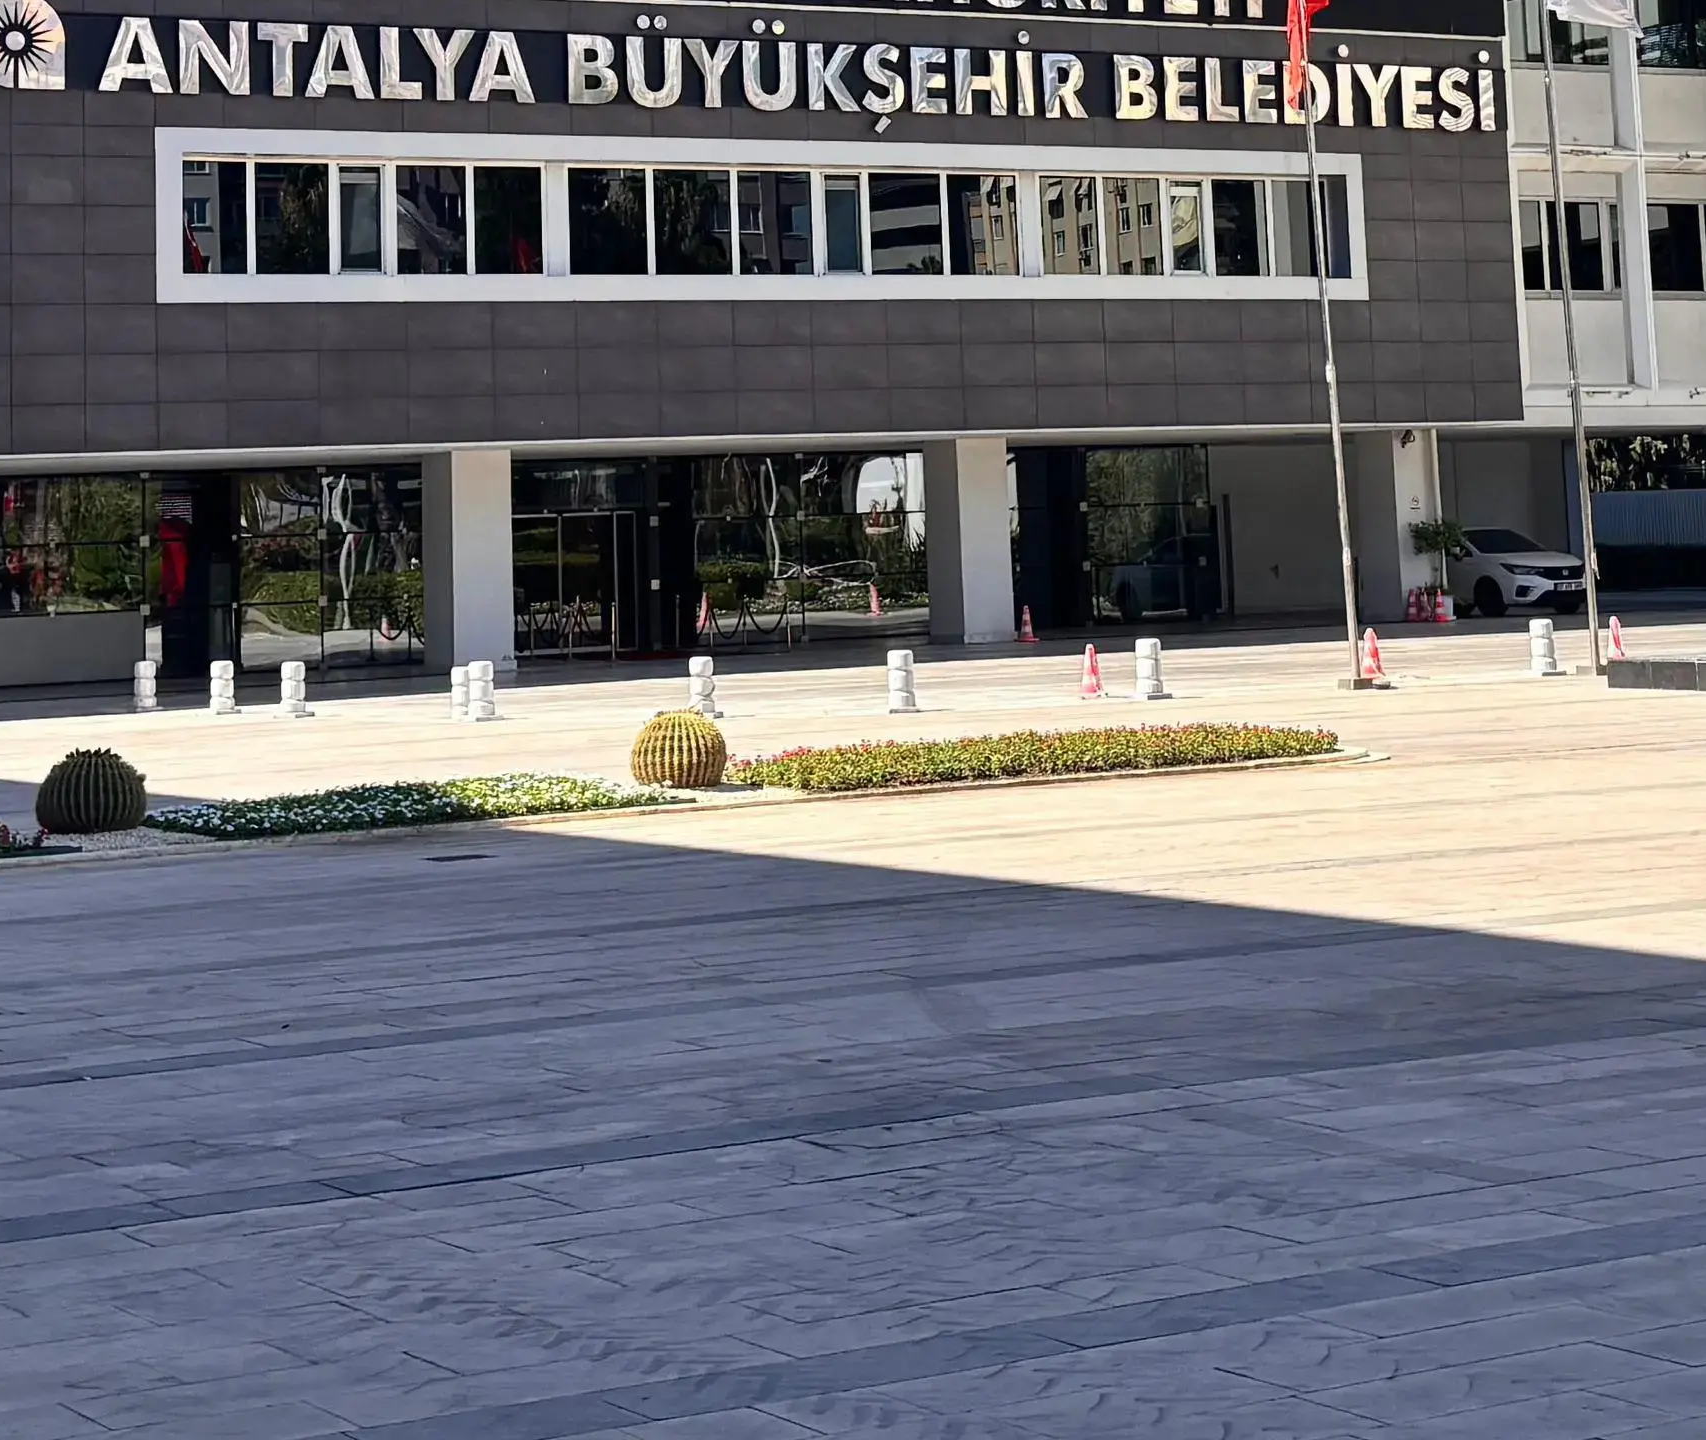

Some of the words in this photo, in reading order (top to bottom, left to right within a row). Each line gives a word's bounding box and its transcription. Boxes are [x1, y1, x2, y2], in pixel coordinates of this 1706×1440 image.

[98, 16, 536, 104] ANTALYA
[567, 14, 1090, 134] BÜYÜKŞEHİR
[1113, 43, 1496, 133] BELEDİYESİ
